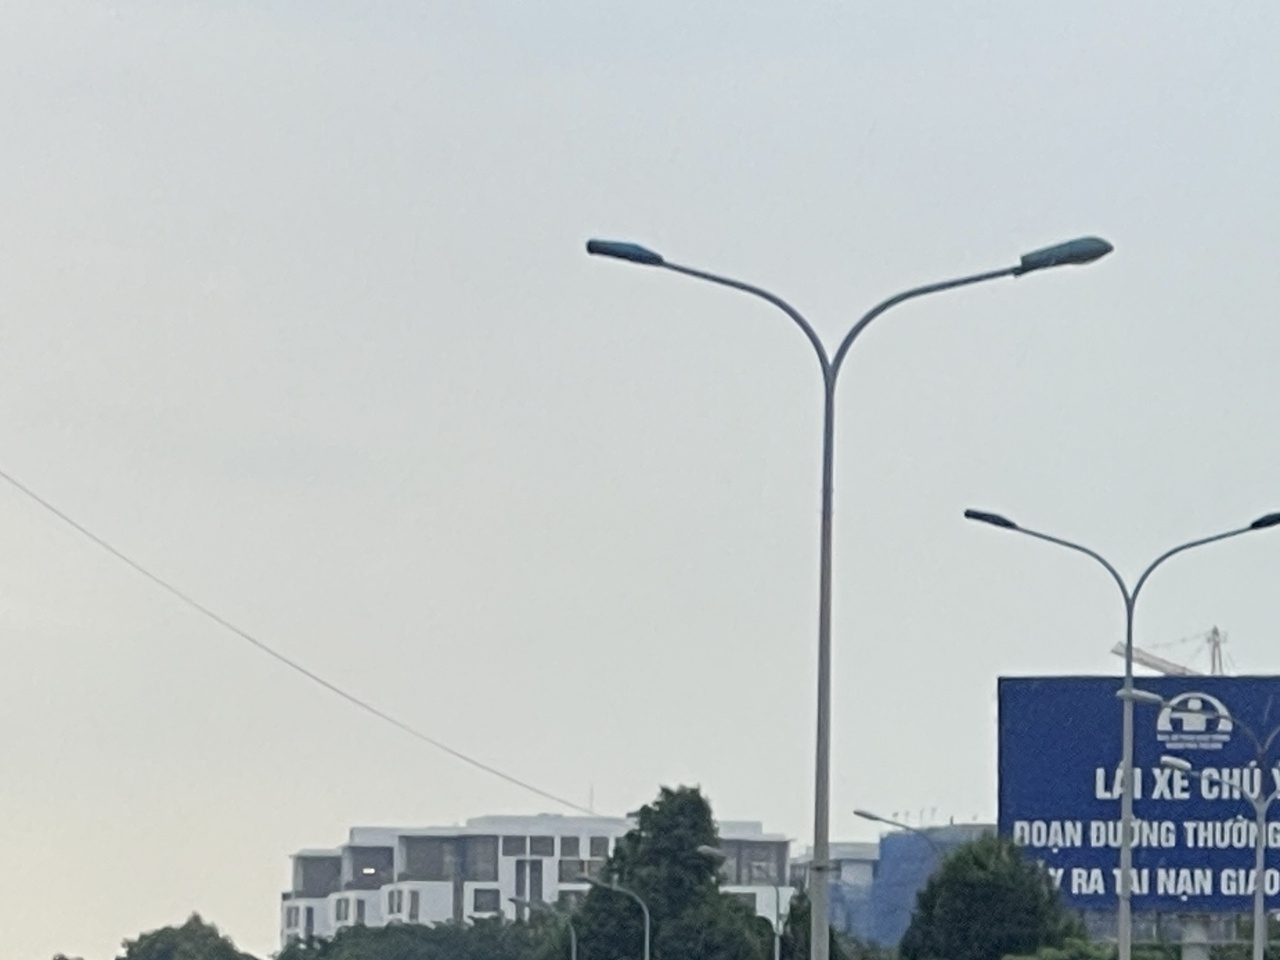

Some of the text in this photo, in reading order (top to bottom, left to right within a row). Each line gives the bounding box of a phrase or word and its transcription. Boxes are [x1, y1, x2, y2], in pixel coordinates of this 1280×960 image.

[1152, 767, 1190, 799] XE
[1201, 760, 1261, 800] CHÚ
[1072, 867, 1105, 894] RA
[1158, 868, 1212, 901] NẠN
